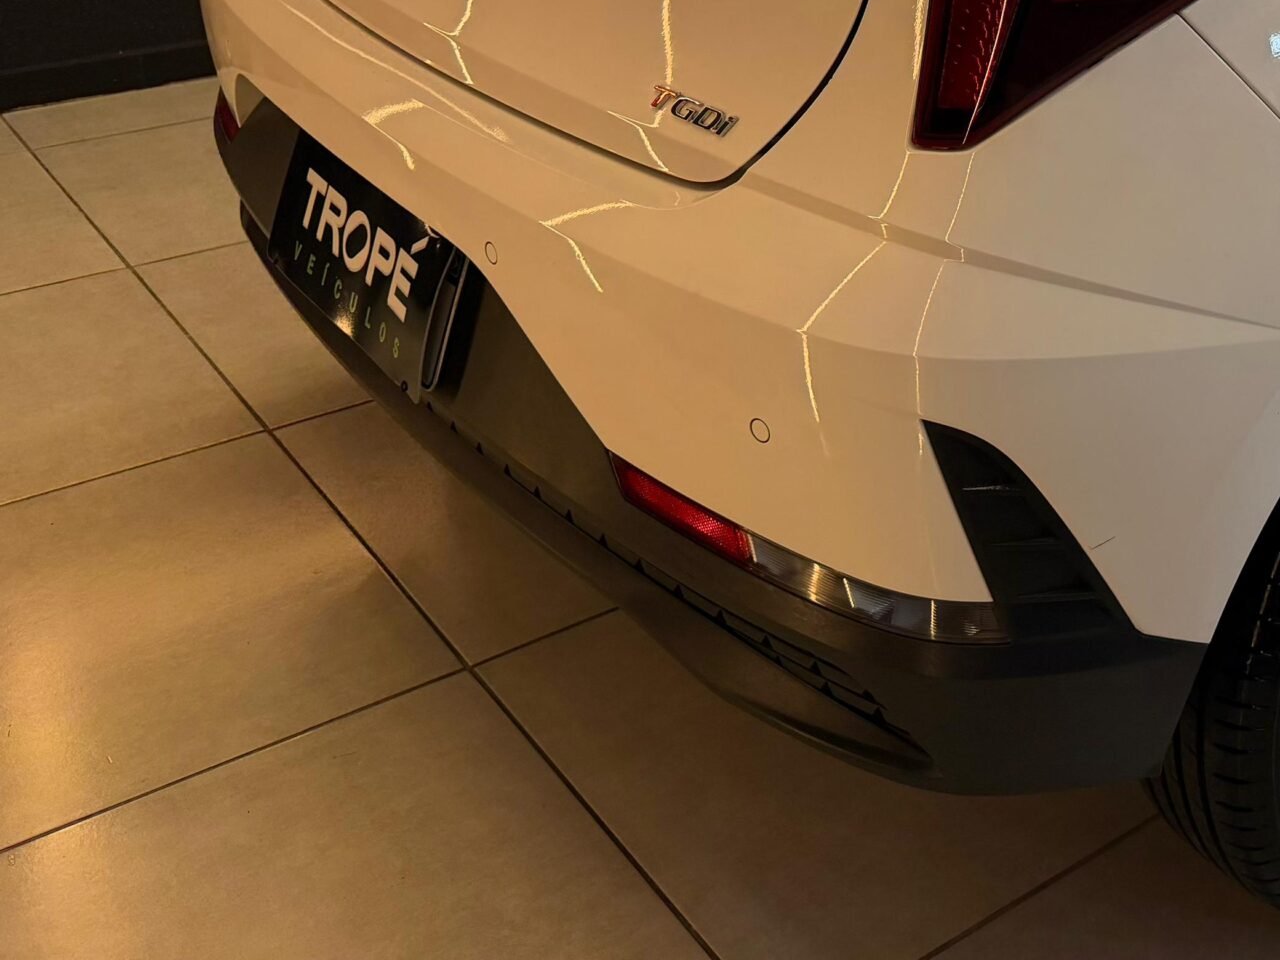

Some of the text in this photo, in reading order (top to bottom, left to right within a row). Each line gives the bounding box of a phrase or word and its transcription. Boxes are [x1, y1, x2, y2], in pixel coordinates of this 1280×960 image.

[650, 85, 739, 138] TGDi
[293, 240, 401, 358] VEÍCULOS
[302, 167, 430, 323] TROPÉ
